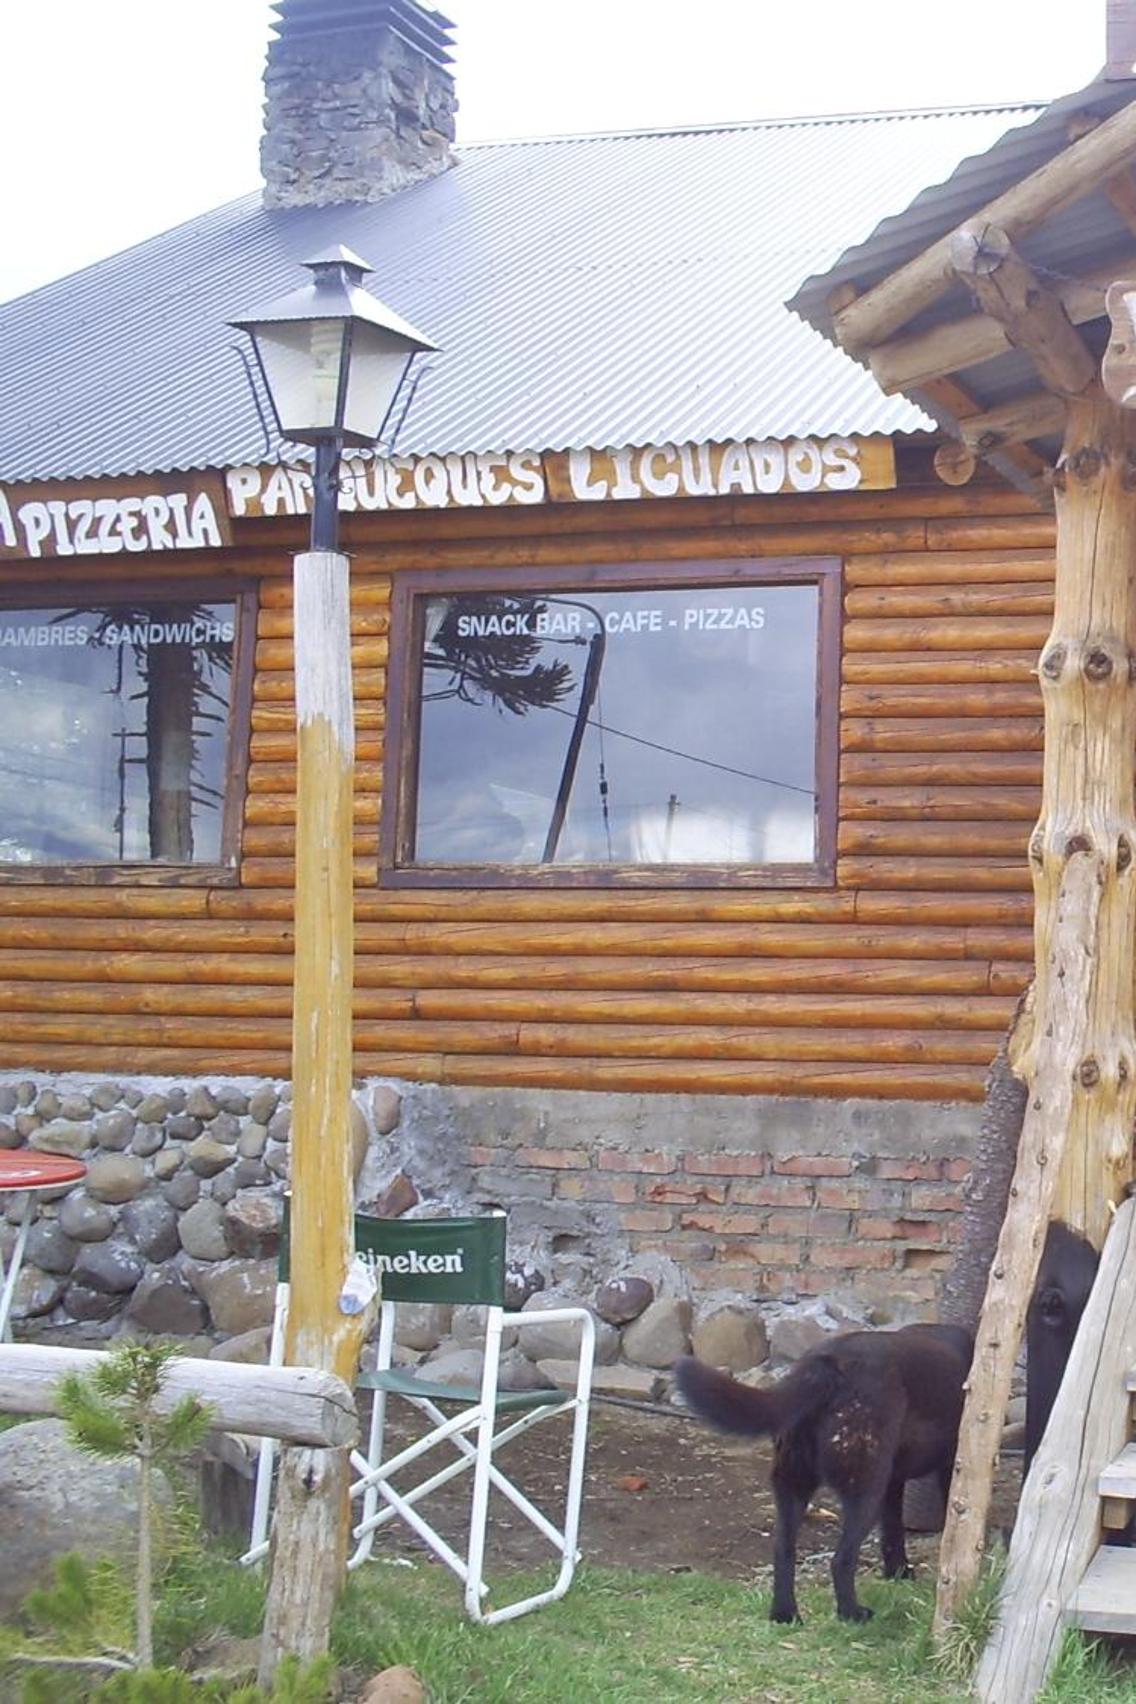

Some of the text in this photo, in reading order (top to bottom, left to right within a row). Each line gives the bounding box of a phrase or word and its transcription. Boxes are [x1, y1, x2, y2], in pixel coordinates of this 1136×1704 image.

[568, 435, 862, 500] LICUADOS
[17, 492, 223, 557] PIZZERIA
[0, 625, 88, 647] AMBRES
[105, 623, 234, 645] SANDWICHS
[457, 613, 529, 636] SNACK
[535, 613, 581, 634] BAR
[606, 610, 662, 633] CAFE
[684, 607, 765, 630] PIZZAS
[354, 1247, 464, 1274] eineken
